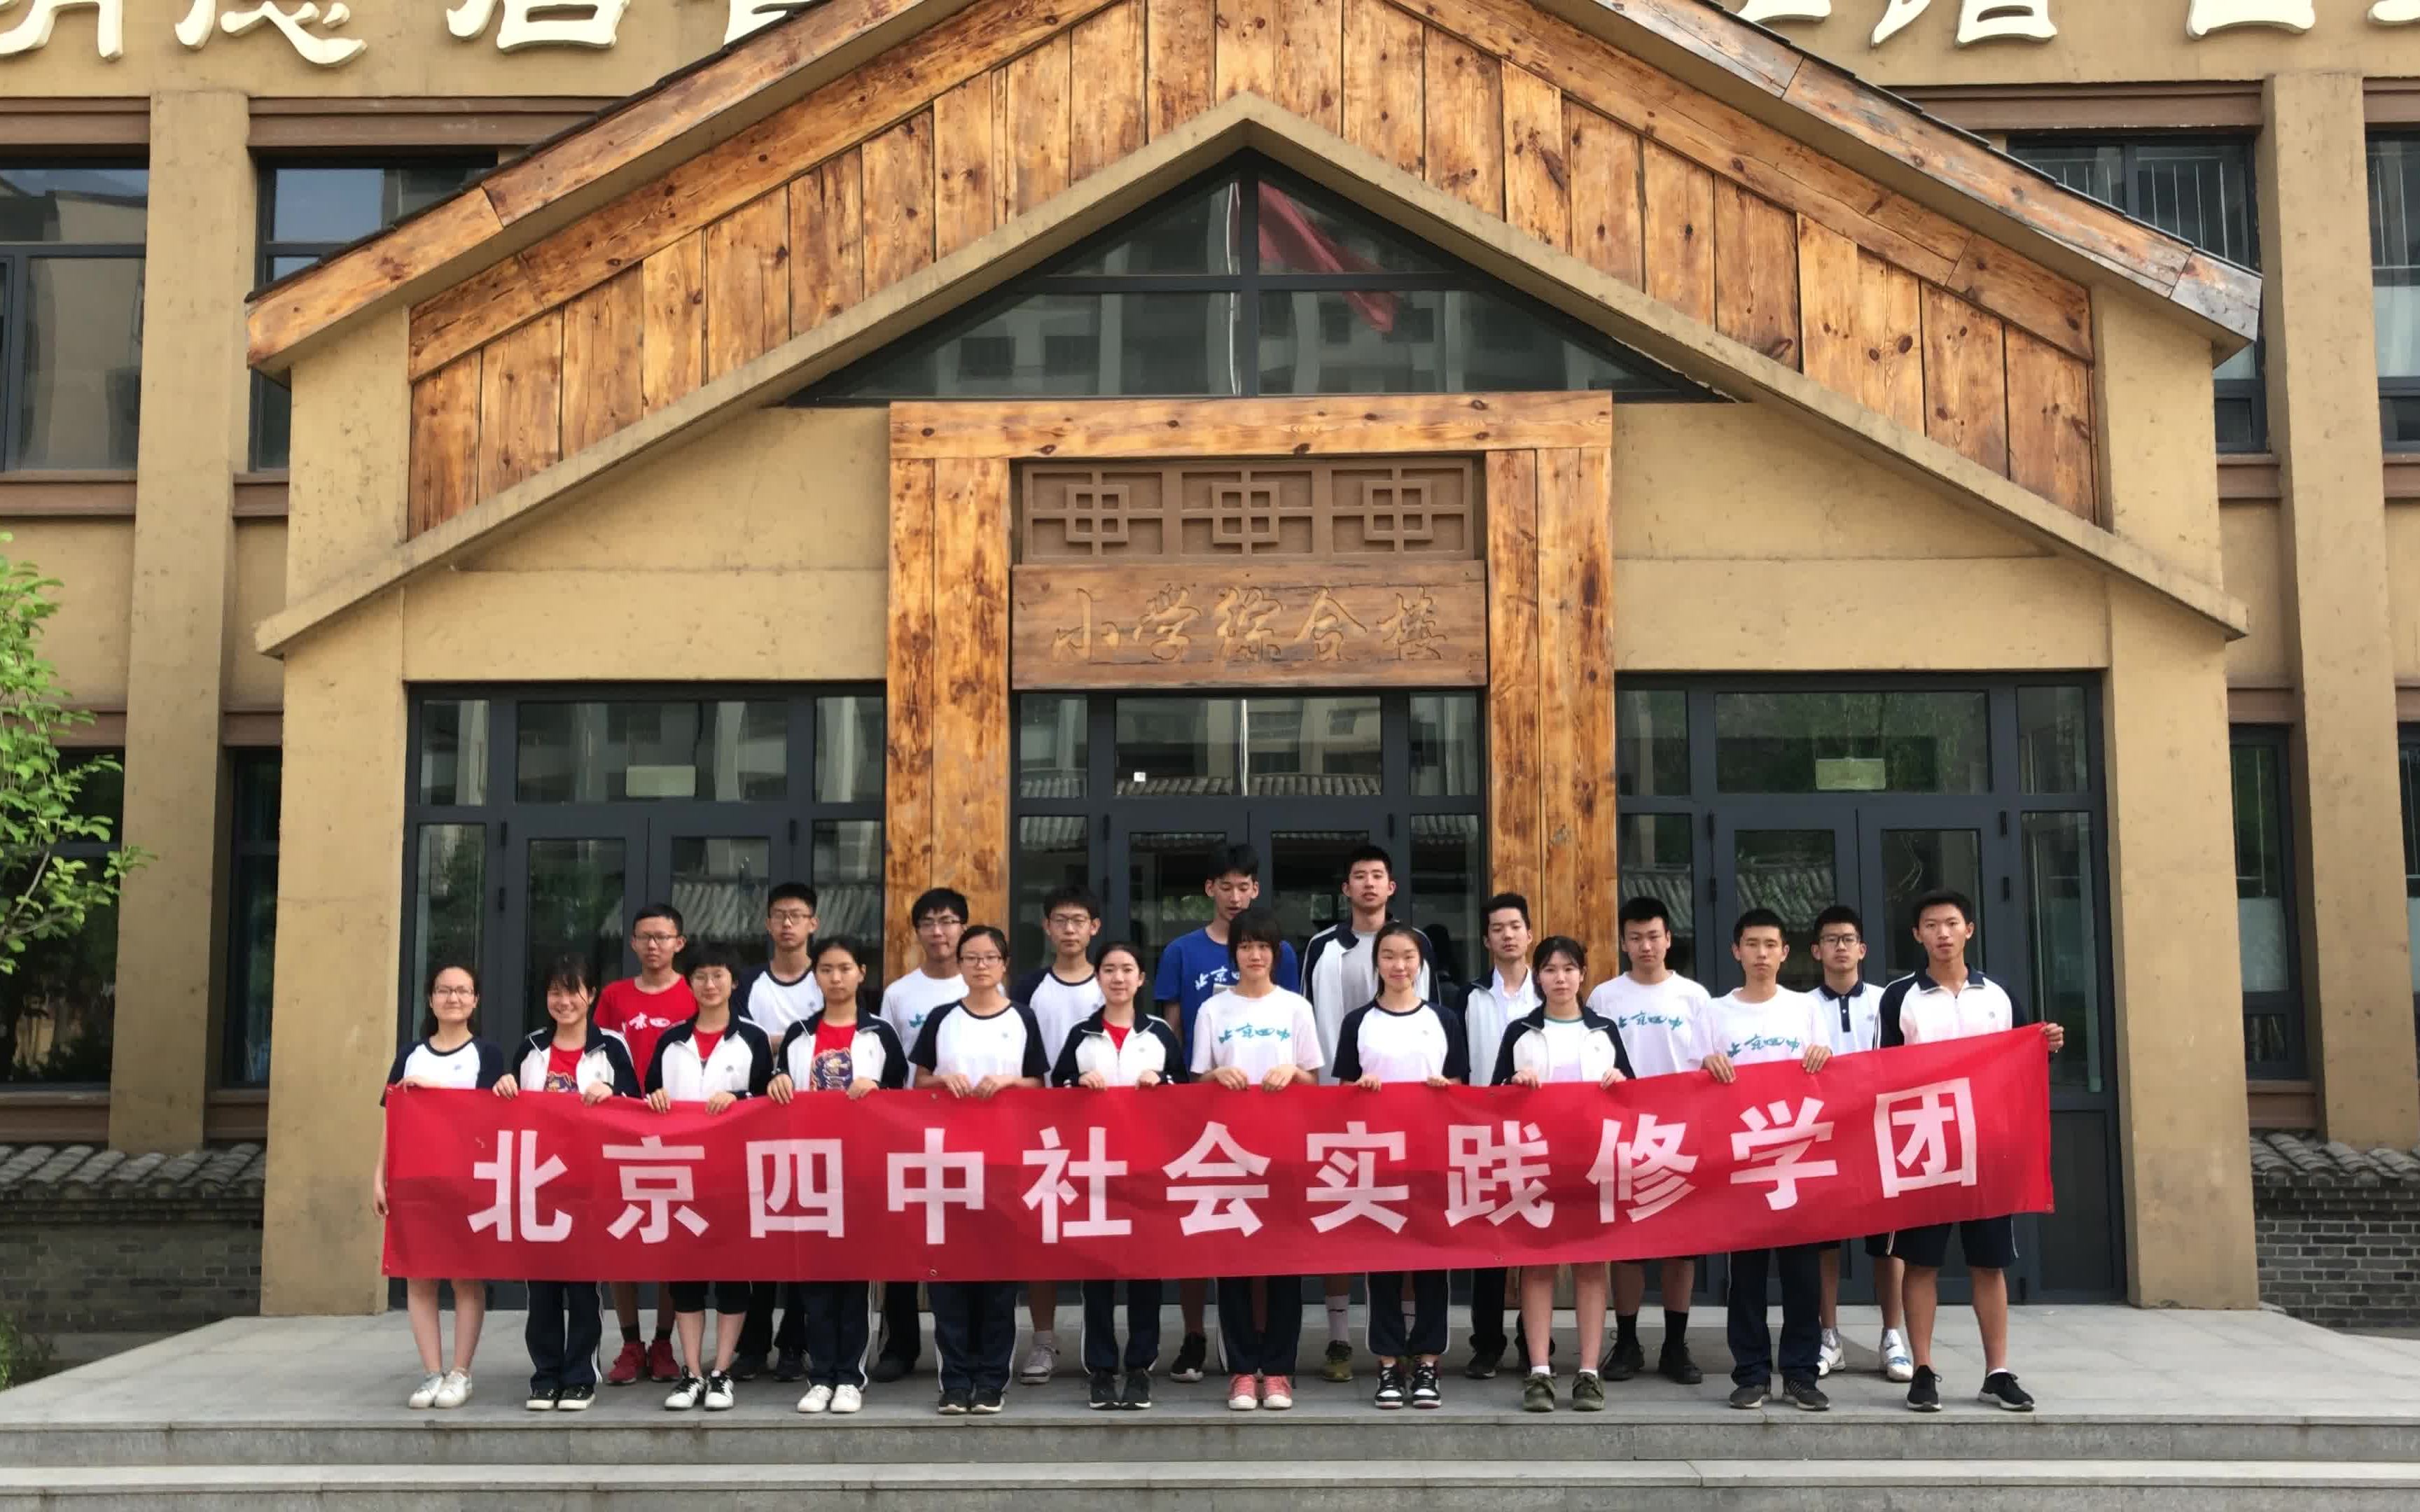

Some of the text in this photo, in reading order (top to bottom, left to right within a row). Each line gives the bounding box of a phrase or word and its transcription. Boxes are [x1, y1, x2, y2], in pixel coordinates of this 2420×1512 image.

[1050, 584, 1448, 662] 小学综合楼
[467, 1077, 1979, 1245] 北京四中社会实践修学团
